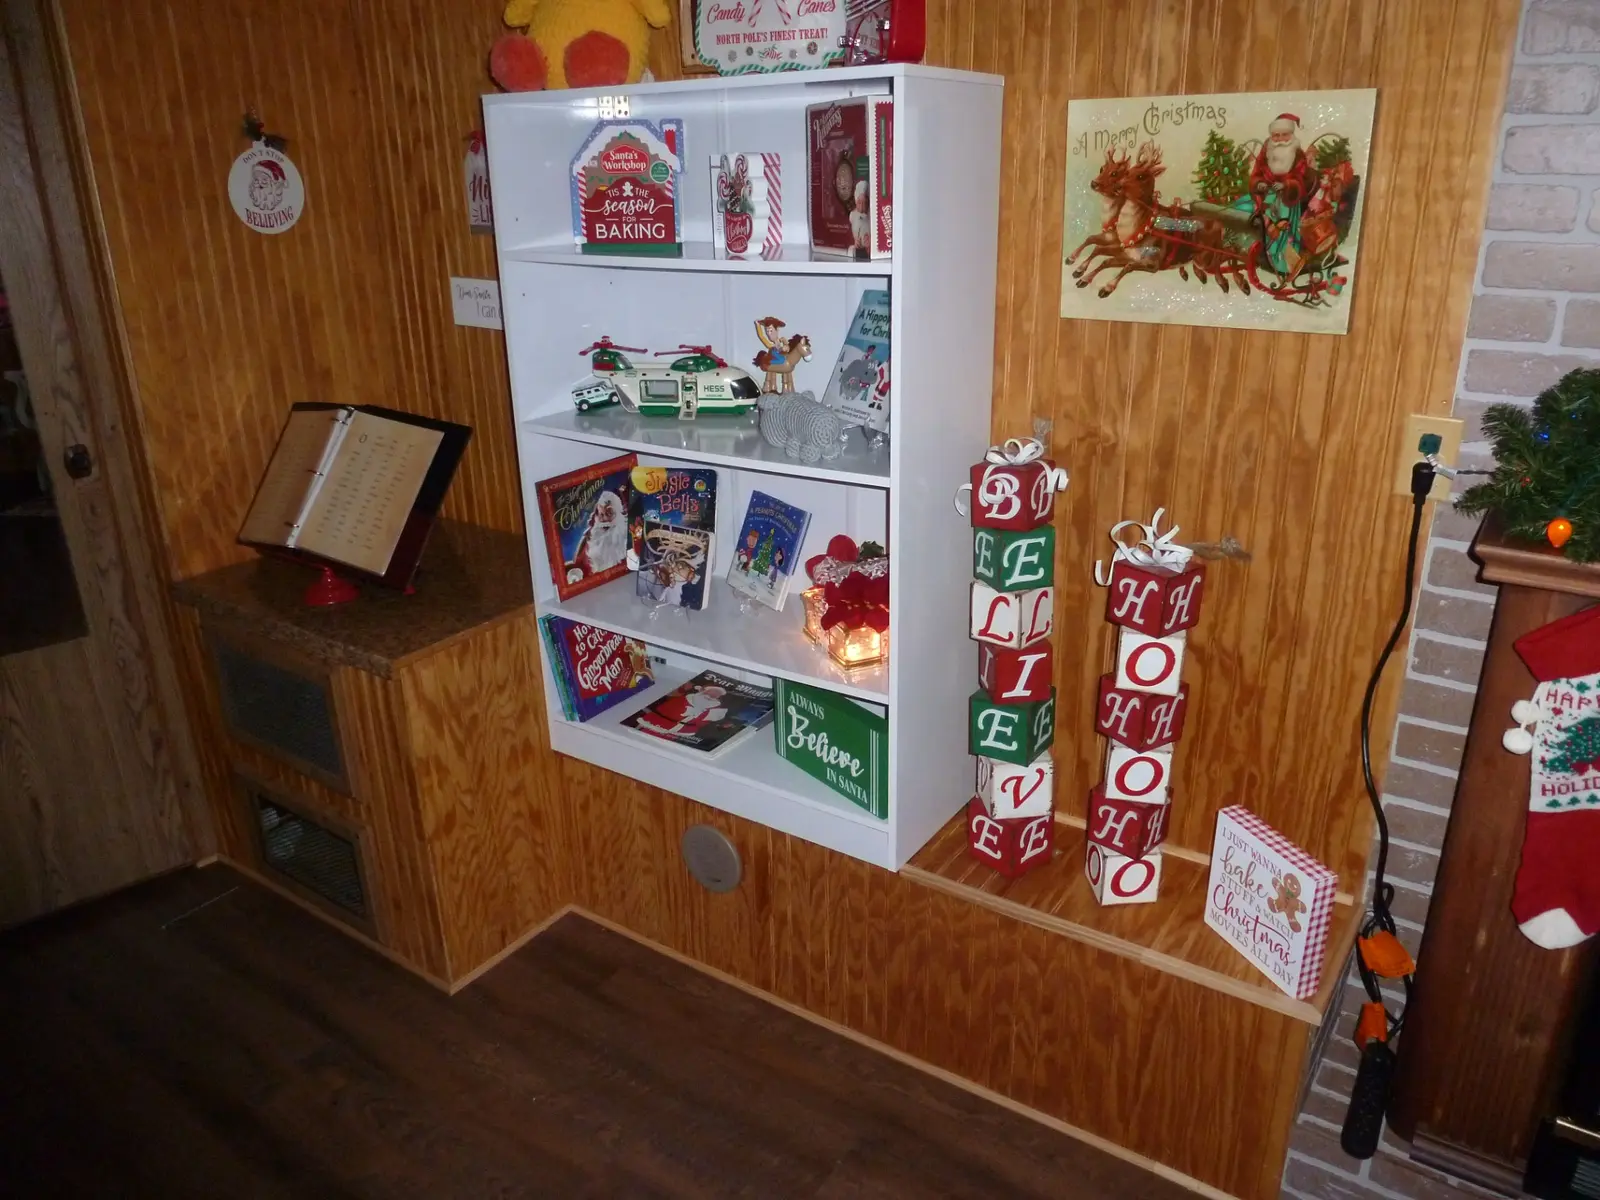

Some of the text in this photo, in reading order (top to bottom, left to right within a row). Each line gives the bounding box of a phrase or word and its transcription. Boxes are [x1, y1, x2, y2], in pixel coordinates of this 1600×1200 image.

[706, 0, 836, 24] Candy Canes
[716, 28, 828, 45] NORTH POLE'S FINEST TREAT!
[1072, 101, 1227, 158] A Merry Christmas
[243, 150, 264, 164] DON'T
[603, 160, 646, 171] Workshop
[609, 150, 638, 161] Santa's
[603, 198, 657, 216] season
[635, 187, 649, 198] THE
[245, 206, 294, 228] BELIEVING
[595, 223, 665, 239] BAKING
[481, 304, 497, 318] can
[859, 309, 865, 319] A
[860, 323, 871, 336] for
[645, 471, 690, 495] Jingle
[657, 494, 699, 514] Bells
[553, 479, 605, 531] Christmas
[1003, 536, 1046, 587] E
[978, 595, 1014, 643] L
[1025, 589, 1049, 644] L
[1113, 577, 1160, 625] H
[1164, 575, 1201, 630] H
[573, 624, 591, 642] Ho
[575, 628, 607, 656] to Catc
[599, 657, 624, 691] Man
[1001, 652, 1048, 699] I
[1125, 641, 1176, 687] O
[789, 691, 824, 720] ALWAYS
[1101, 692, 1140, 738] H
[1146, 693, 1185, 745] H
[787, 705, 864, 777] Believe
[977, 708, 1018, 751] E
[827, 767, 868, 803] IN SANTA
[1001, 768, 1045, 810] V
[1114, 756, 1164, 797] O
[972, 814, 1003, 860] E
[1020, 815, 1049, 864] E
[1093, 805, 1138, 848] H
[1220, 845, 1268, 899] bake
[1221, 826, 1282, 880] I JUST WANNA
[1110, 859, 1155, 898] O
[1213, 884, 1296, 967] Christmas
[1219, 873, 1255, 906] STUFF
[1263, 909, 1294, 941] WATCH
[1209, 908, 1294, 988] MOVIES ALL DAY
